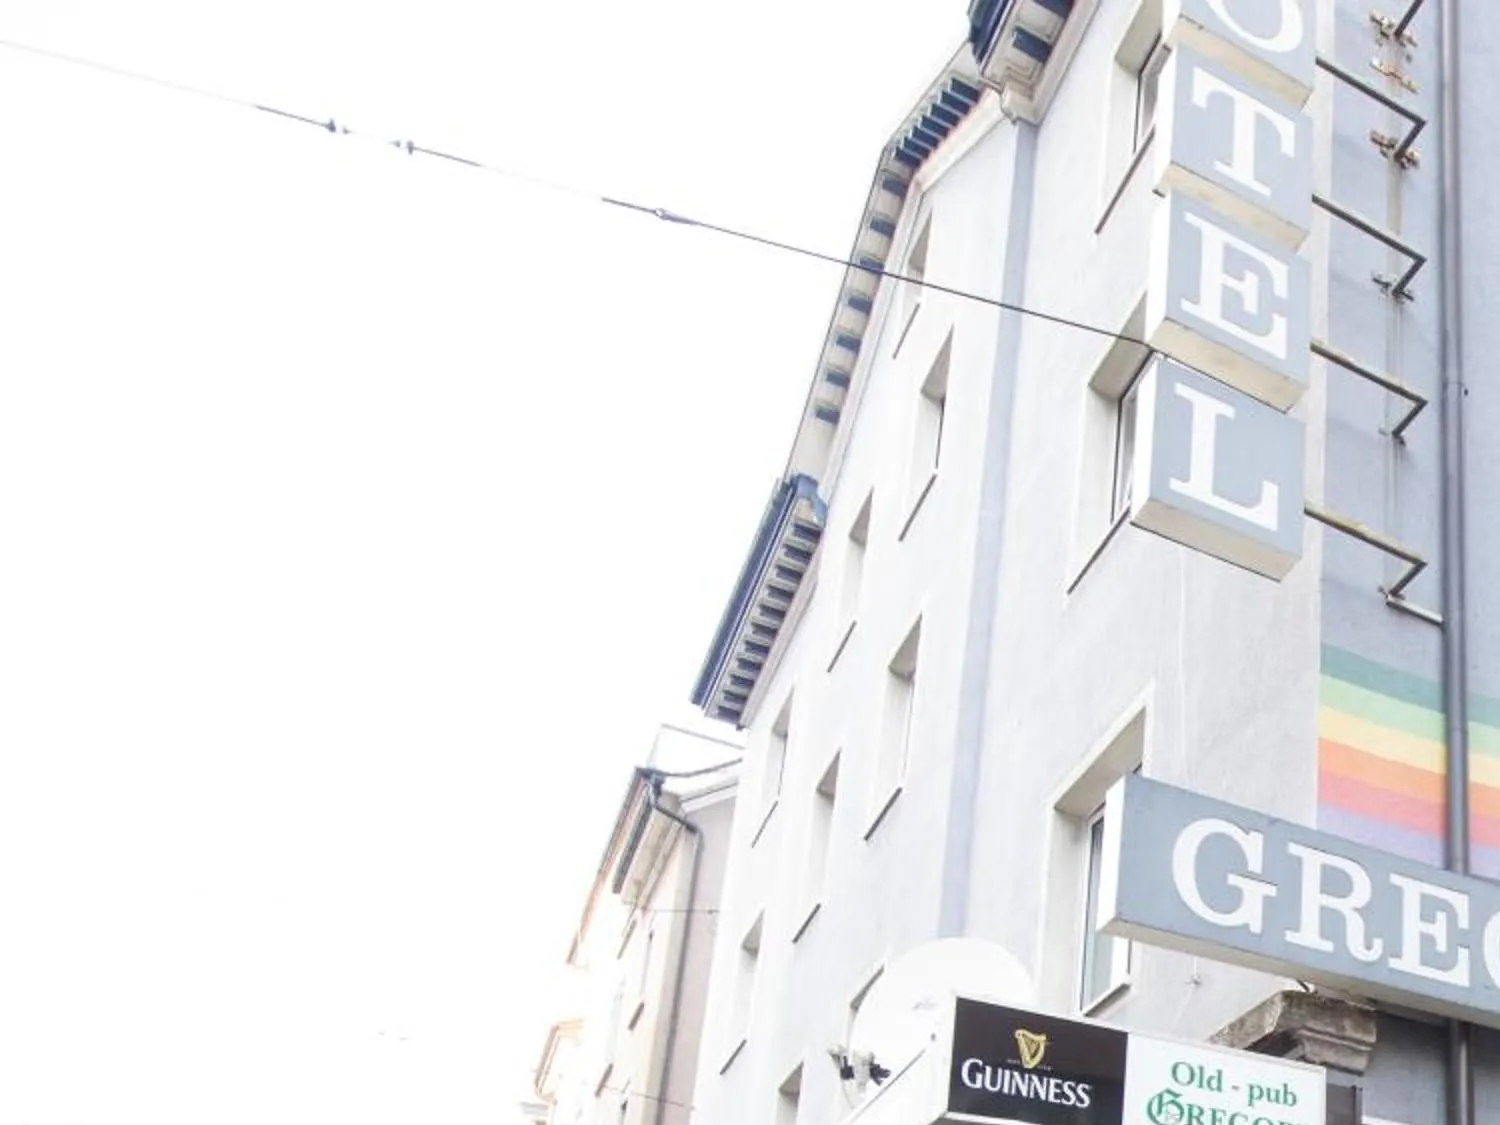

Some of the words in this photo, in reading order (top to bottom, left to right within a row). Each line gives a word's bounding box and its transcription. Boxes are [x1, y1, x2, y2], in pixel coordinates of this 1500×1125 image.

[960, 1057, 1092, 1109] GUINNESS
[1171, 1061, 1223, 1093] Old
[1248, 1082, 1298, 1108] pub
